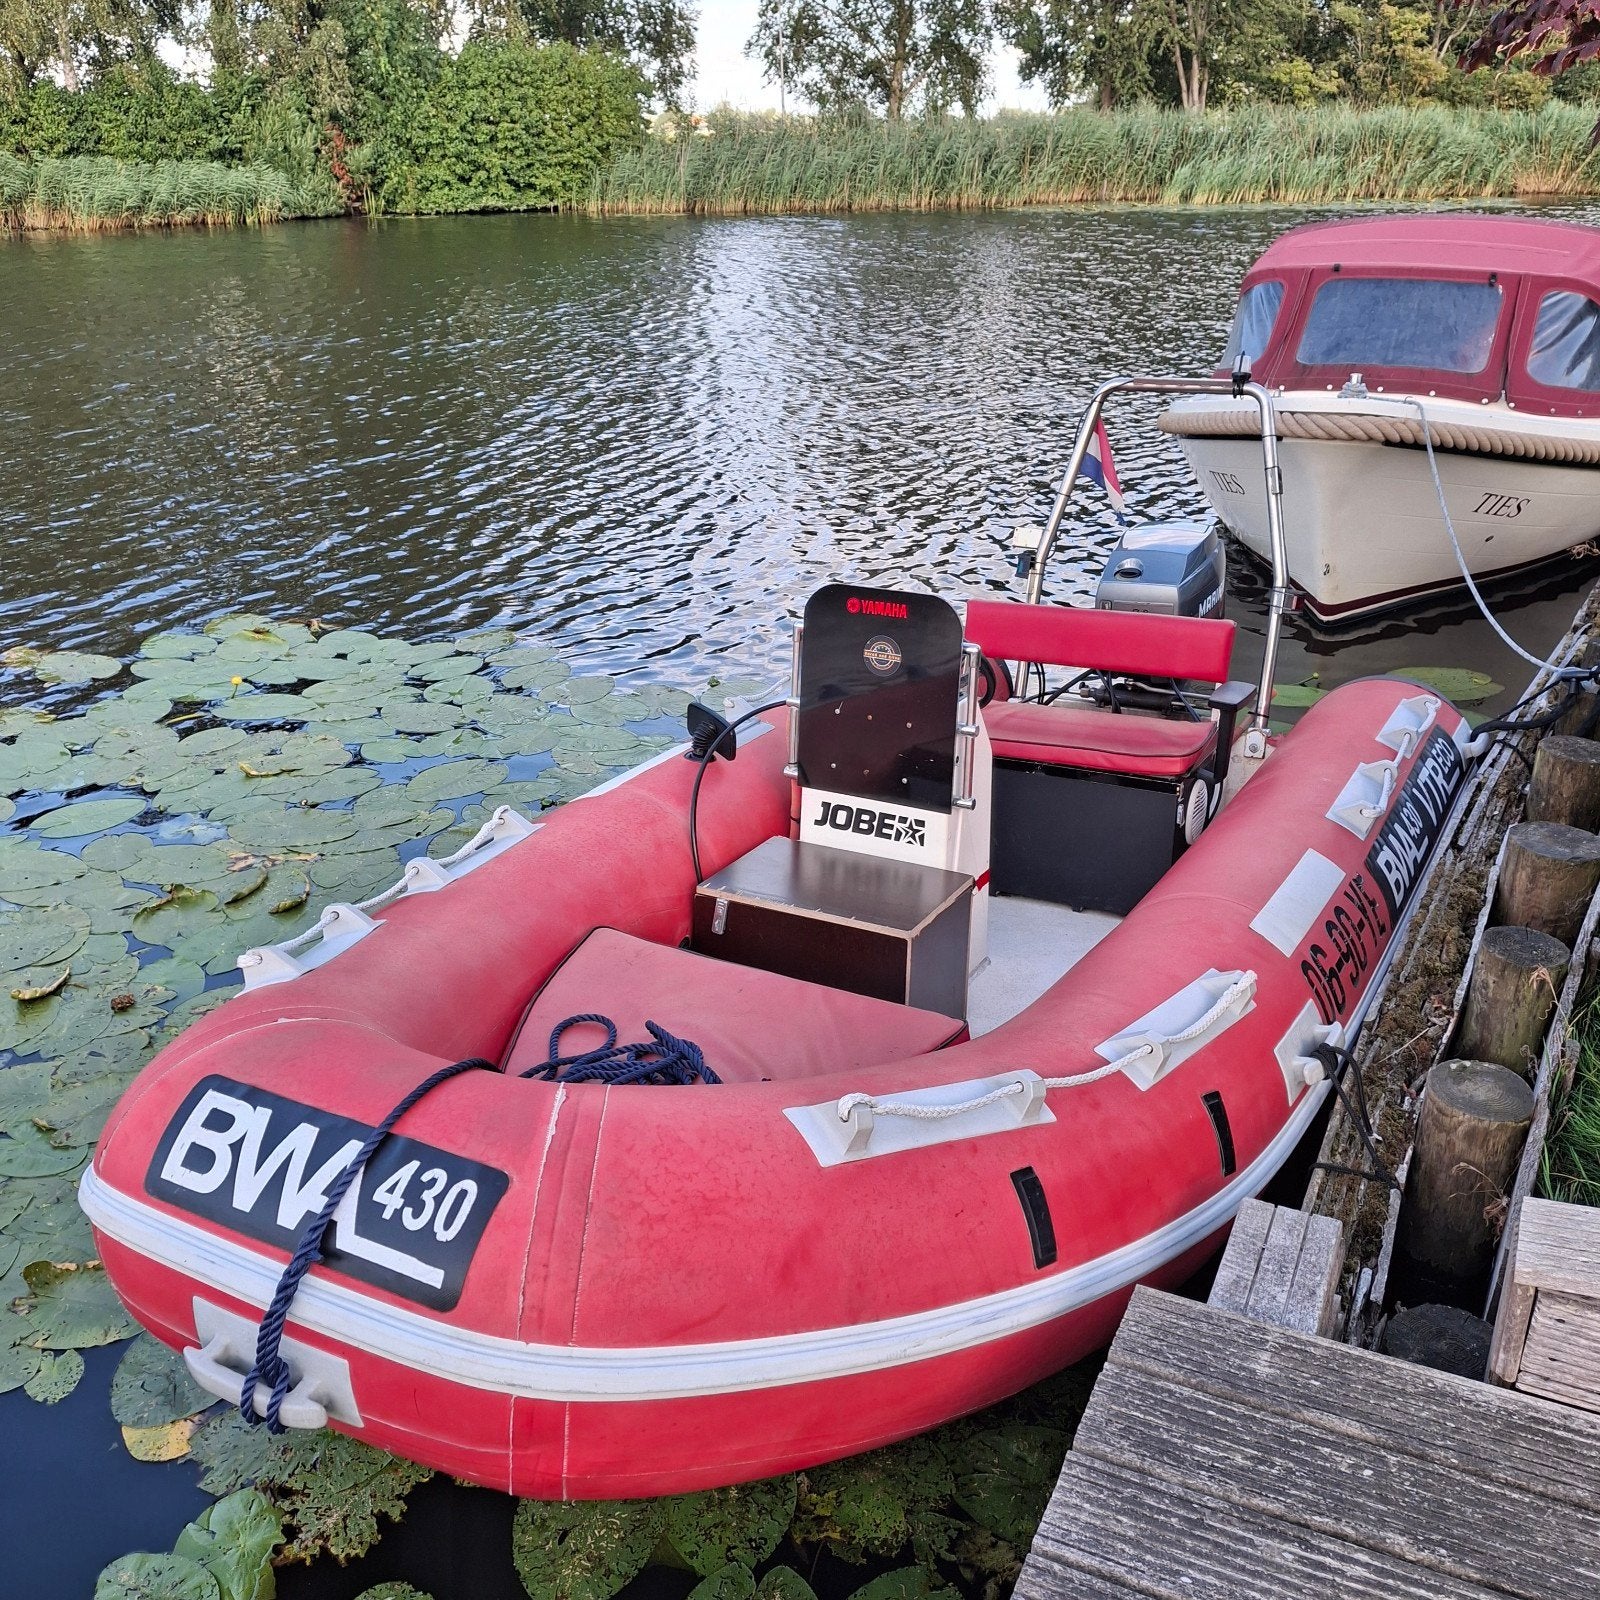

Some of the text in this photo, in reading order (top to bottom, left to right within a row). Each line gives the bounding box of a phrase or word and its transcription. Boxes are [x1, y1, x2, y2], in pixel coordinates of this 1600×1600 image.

[1209, 470, 1246, 495] TIES
[1471, 492, 1531, 518] TIES
[861, 600, 907, 619] YAMAHA
[1412, 757, 1460, 827] VTR
[814, 801, 896, 841] JOBE
[1400, 801, 1423, 838] 430
[160, 1088, 478, 1290] BWA 430
